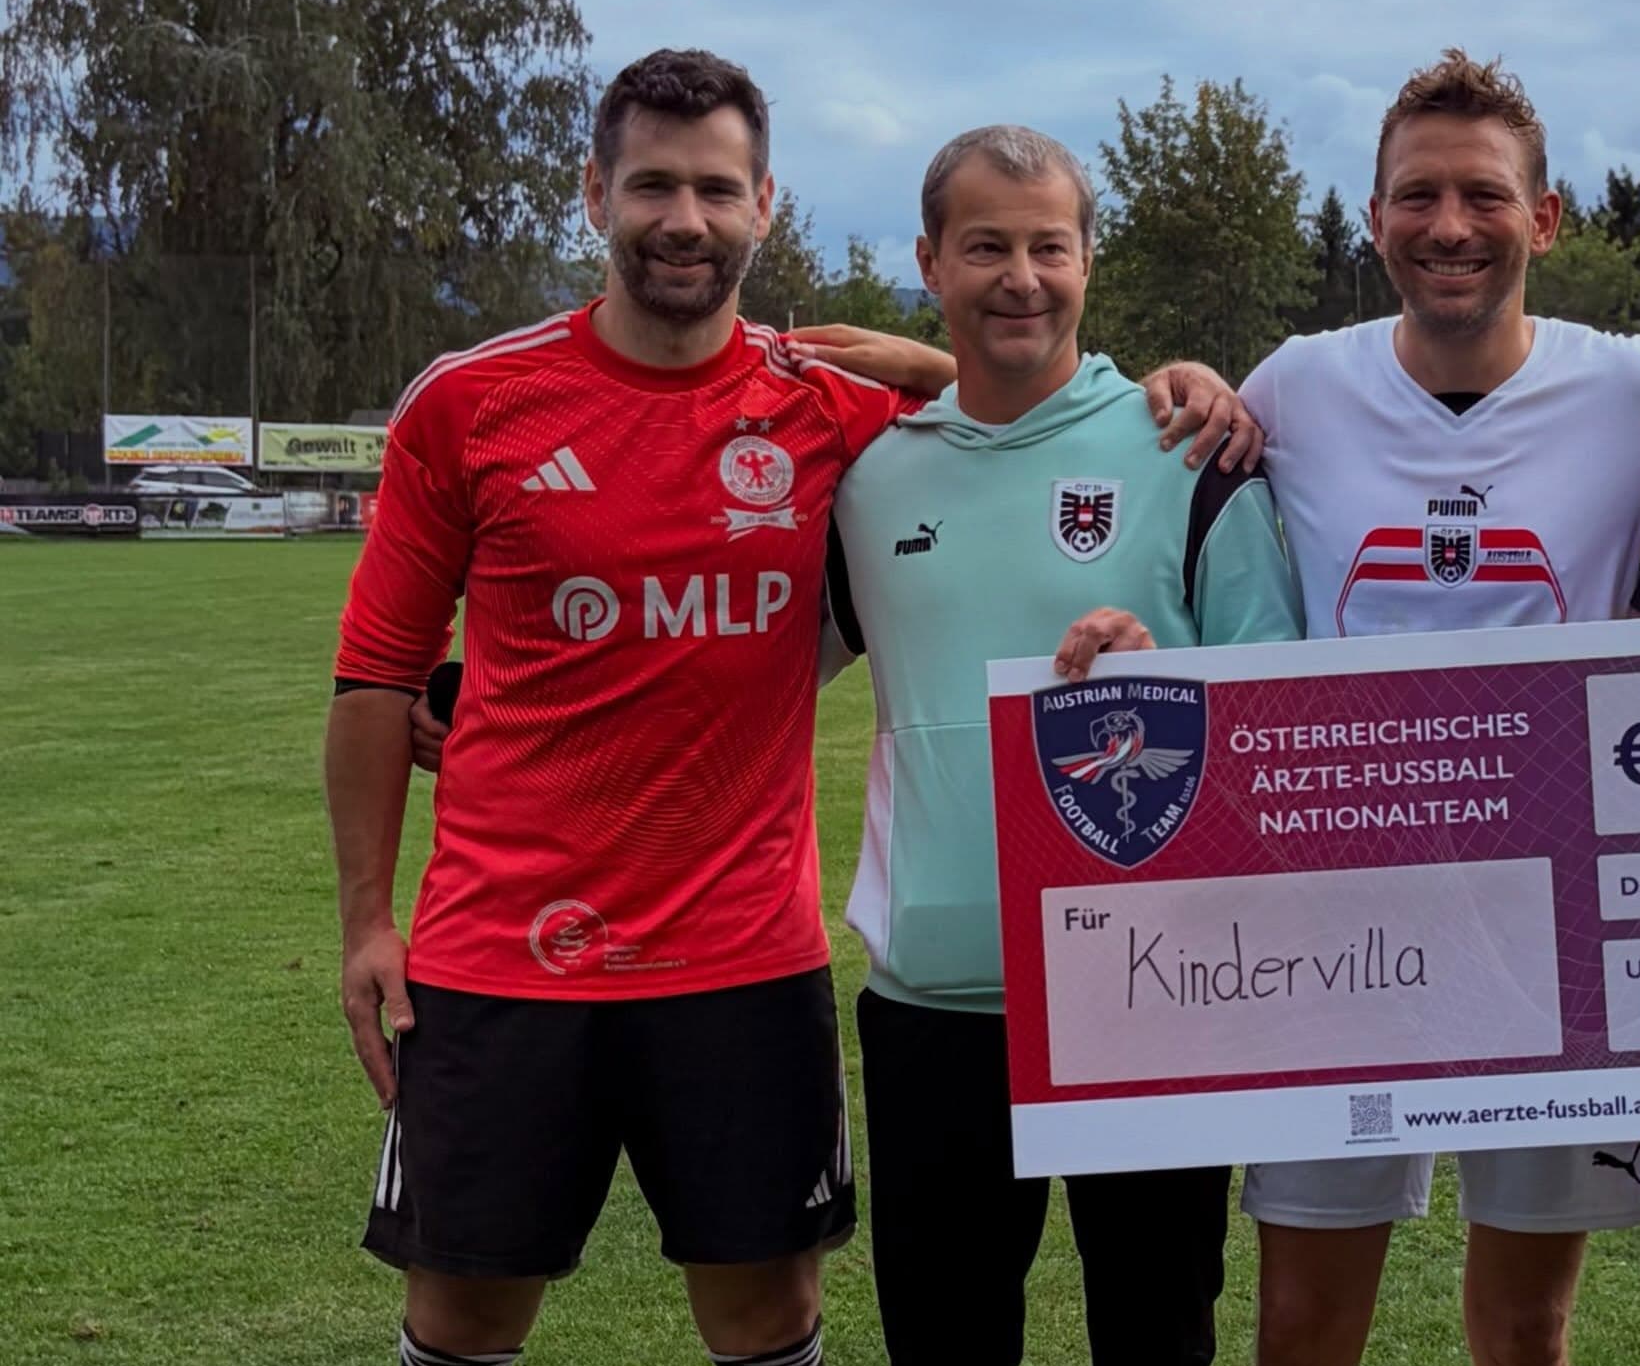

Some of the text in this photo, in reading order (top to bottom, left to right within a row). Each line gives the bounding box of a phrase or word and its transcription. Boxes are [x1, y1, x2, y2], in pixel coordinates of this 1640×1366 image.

[1428, 500, 1478, 516] PUMA
[895, 536, 931, 556] PUMA
[644, 571, 792, 638] MLP
[1043, 683, 1198, 713] AUSTRIAN MEDICAL
[1229, 712, 1531, 753] ÖSTERREICHISCHES
[1251, 755, 1514, 794] ÄRZTE-FUSSBALL
[1054, 784, 1119, 855] FOOTBALL
[1140, 803, 1184, 843] TEAM
[1259, 797, 1510, 835] NATIONALTEAM
[1064, 908, 1110, 932] Für
[1127, 921, 1428, 1009] Kindervilla
